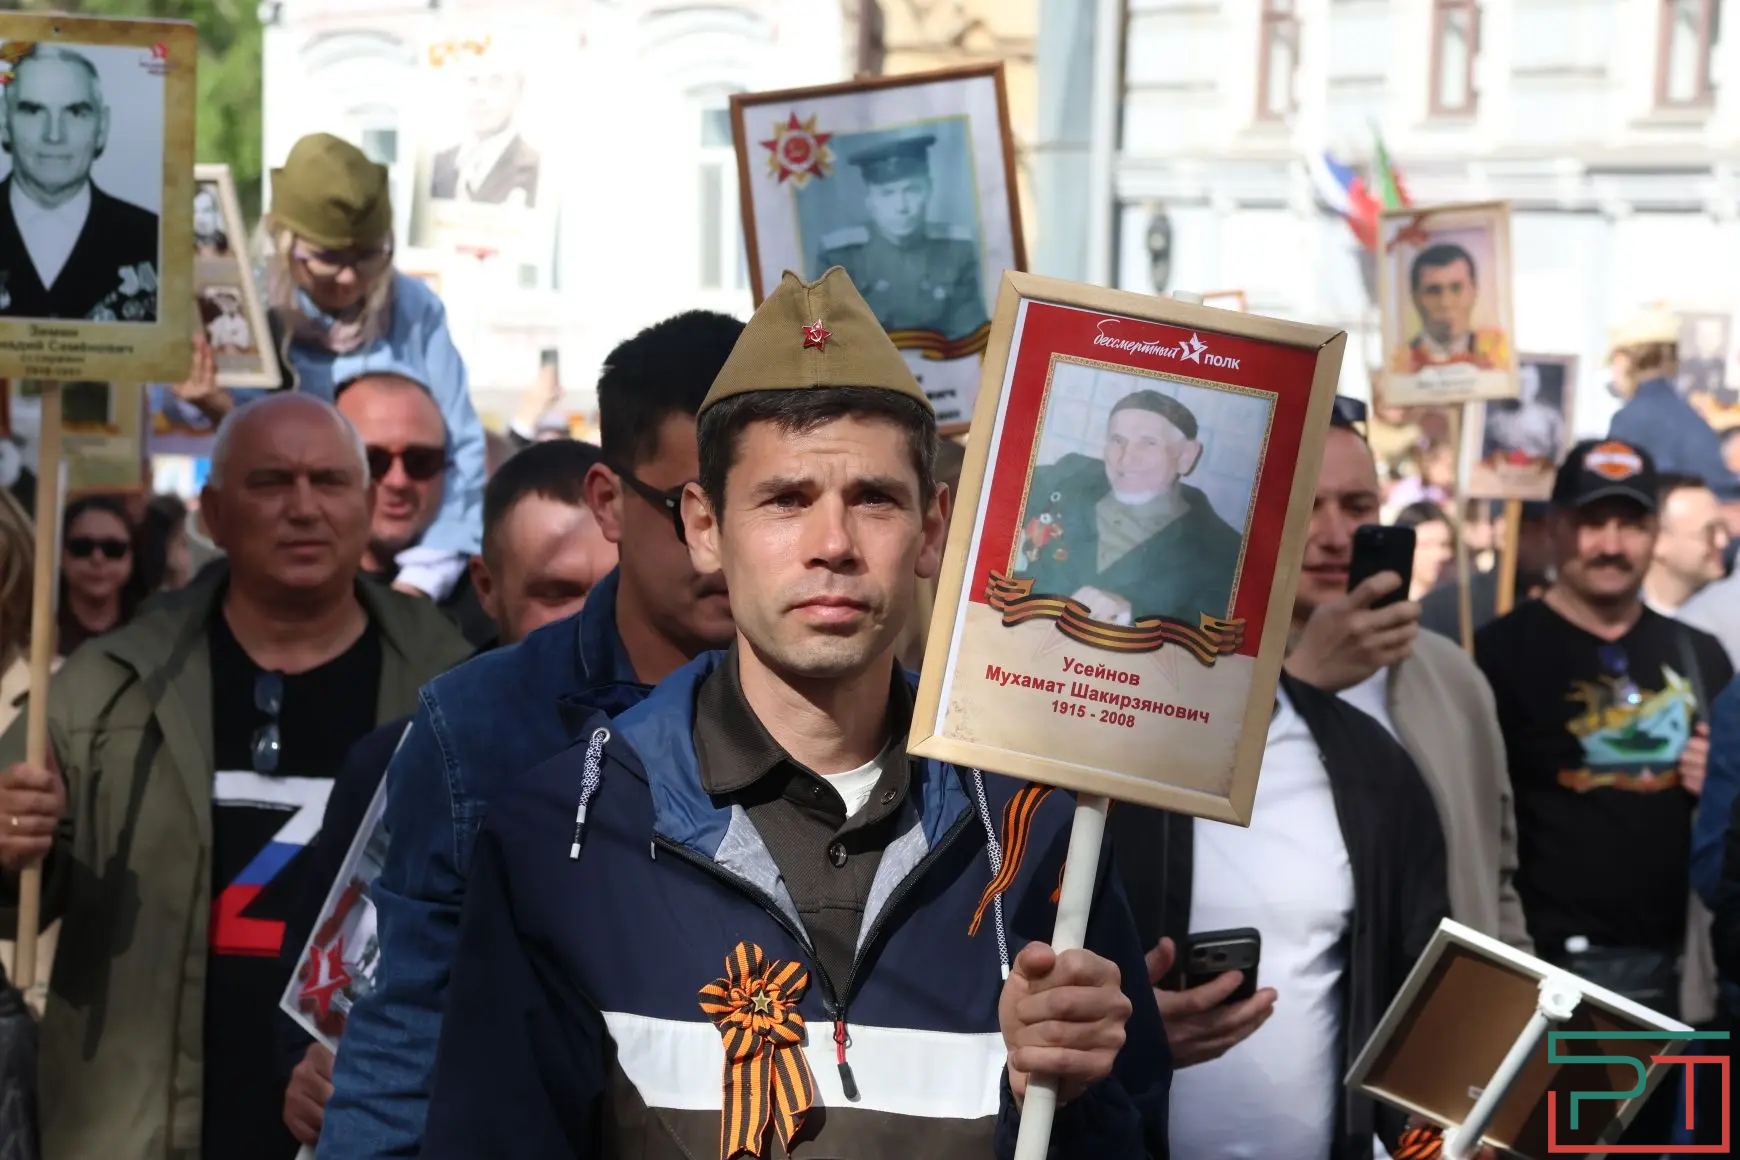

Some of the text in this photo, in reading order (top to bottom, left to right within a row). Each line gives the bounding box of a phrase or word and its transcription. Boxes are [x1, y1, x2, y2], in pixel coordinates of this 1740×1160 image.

[1094, 319, 1181, 359] бессмертный
[1062, 656, 1141, 686] Усейнов
[985, 664, 1210, 724] Мухамат Шакирзянович
[1051, 699, 1087, 719] 1915
[1100, 709, 1136, 728] 2008
[206, 771, 335, 957] Z
